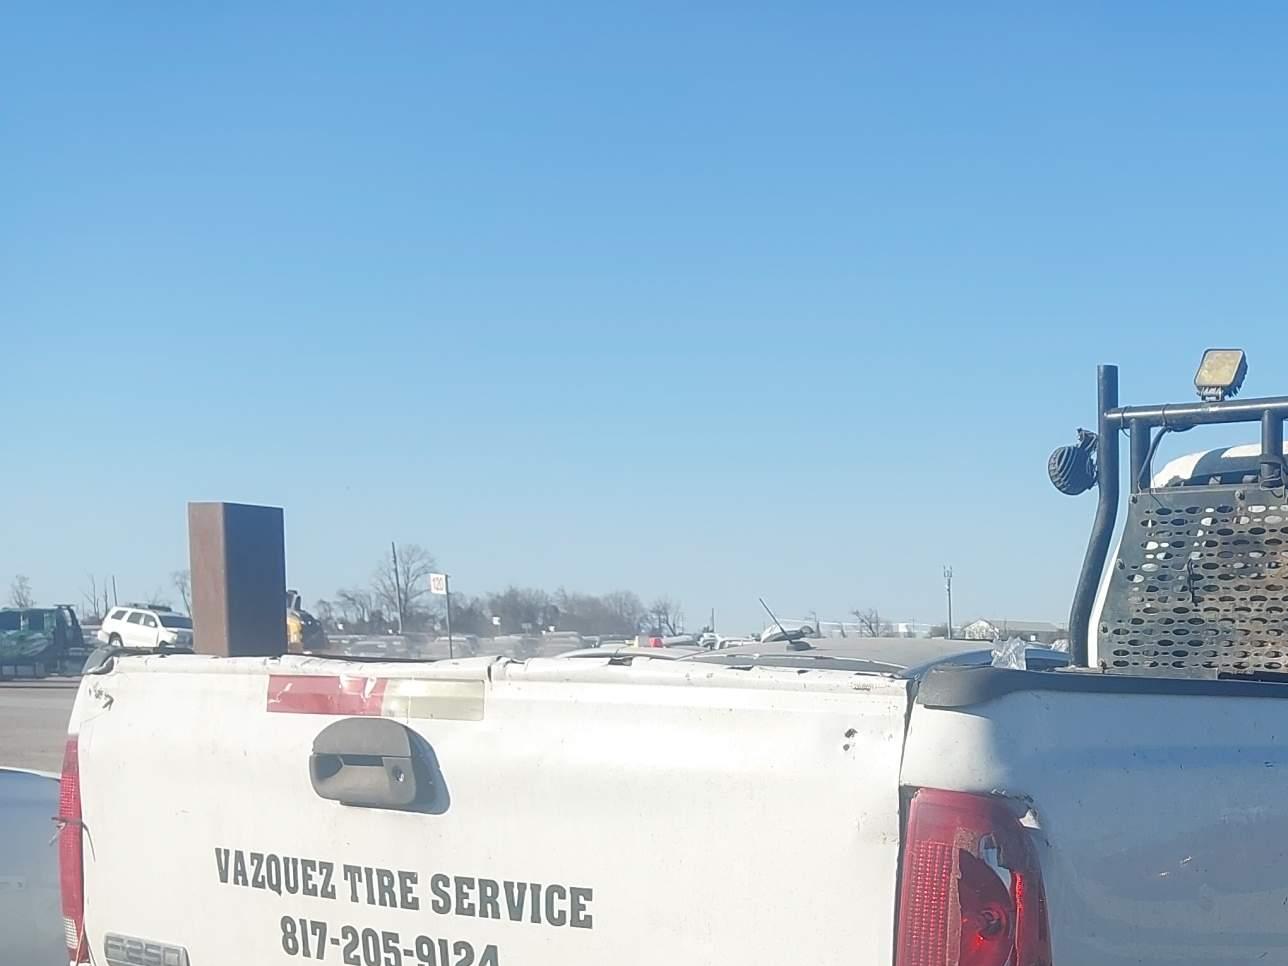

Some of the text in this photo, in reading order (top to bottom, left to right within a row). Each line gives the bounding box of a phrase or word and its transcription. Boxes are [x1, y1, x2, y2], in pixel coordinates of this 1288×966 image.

[214, 847, 594, 929] VAZQUEZ TIRE SERVICE
